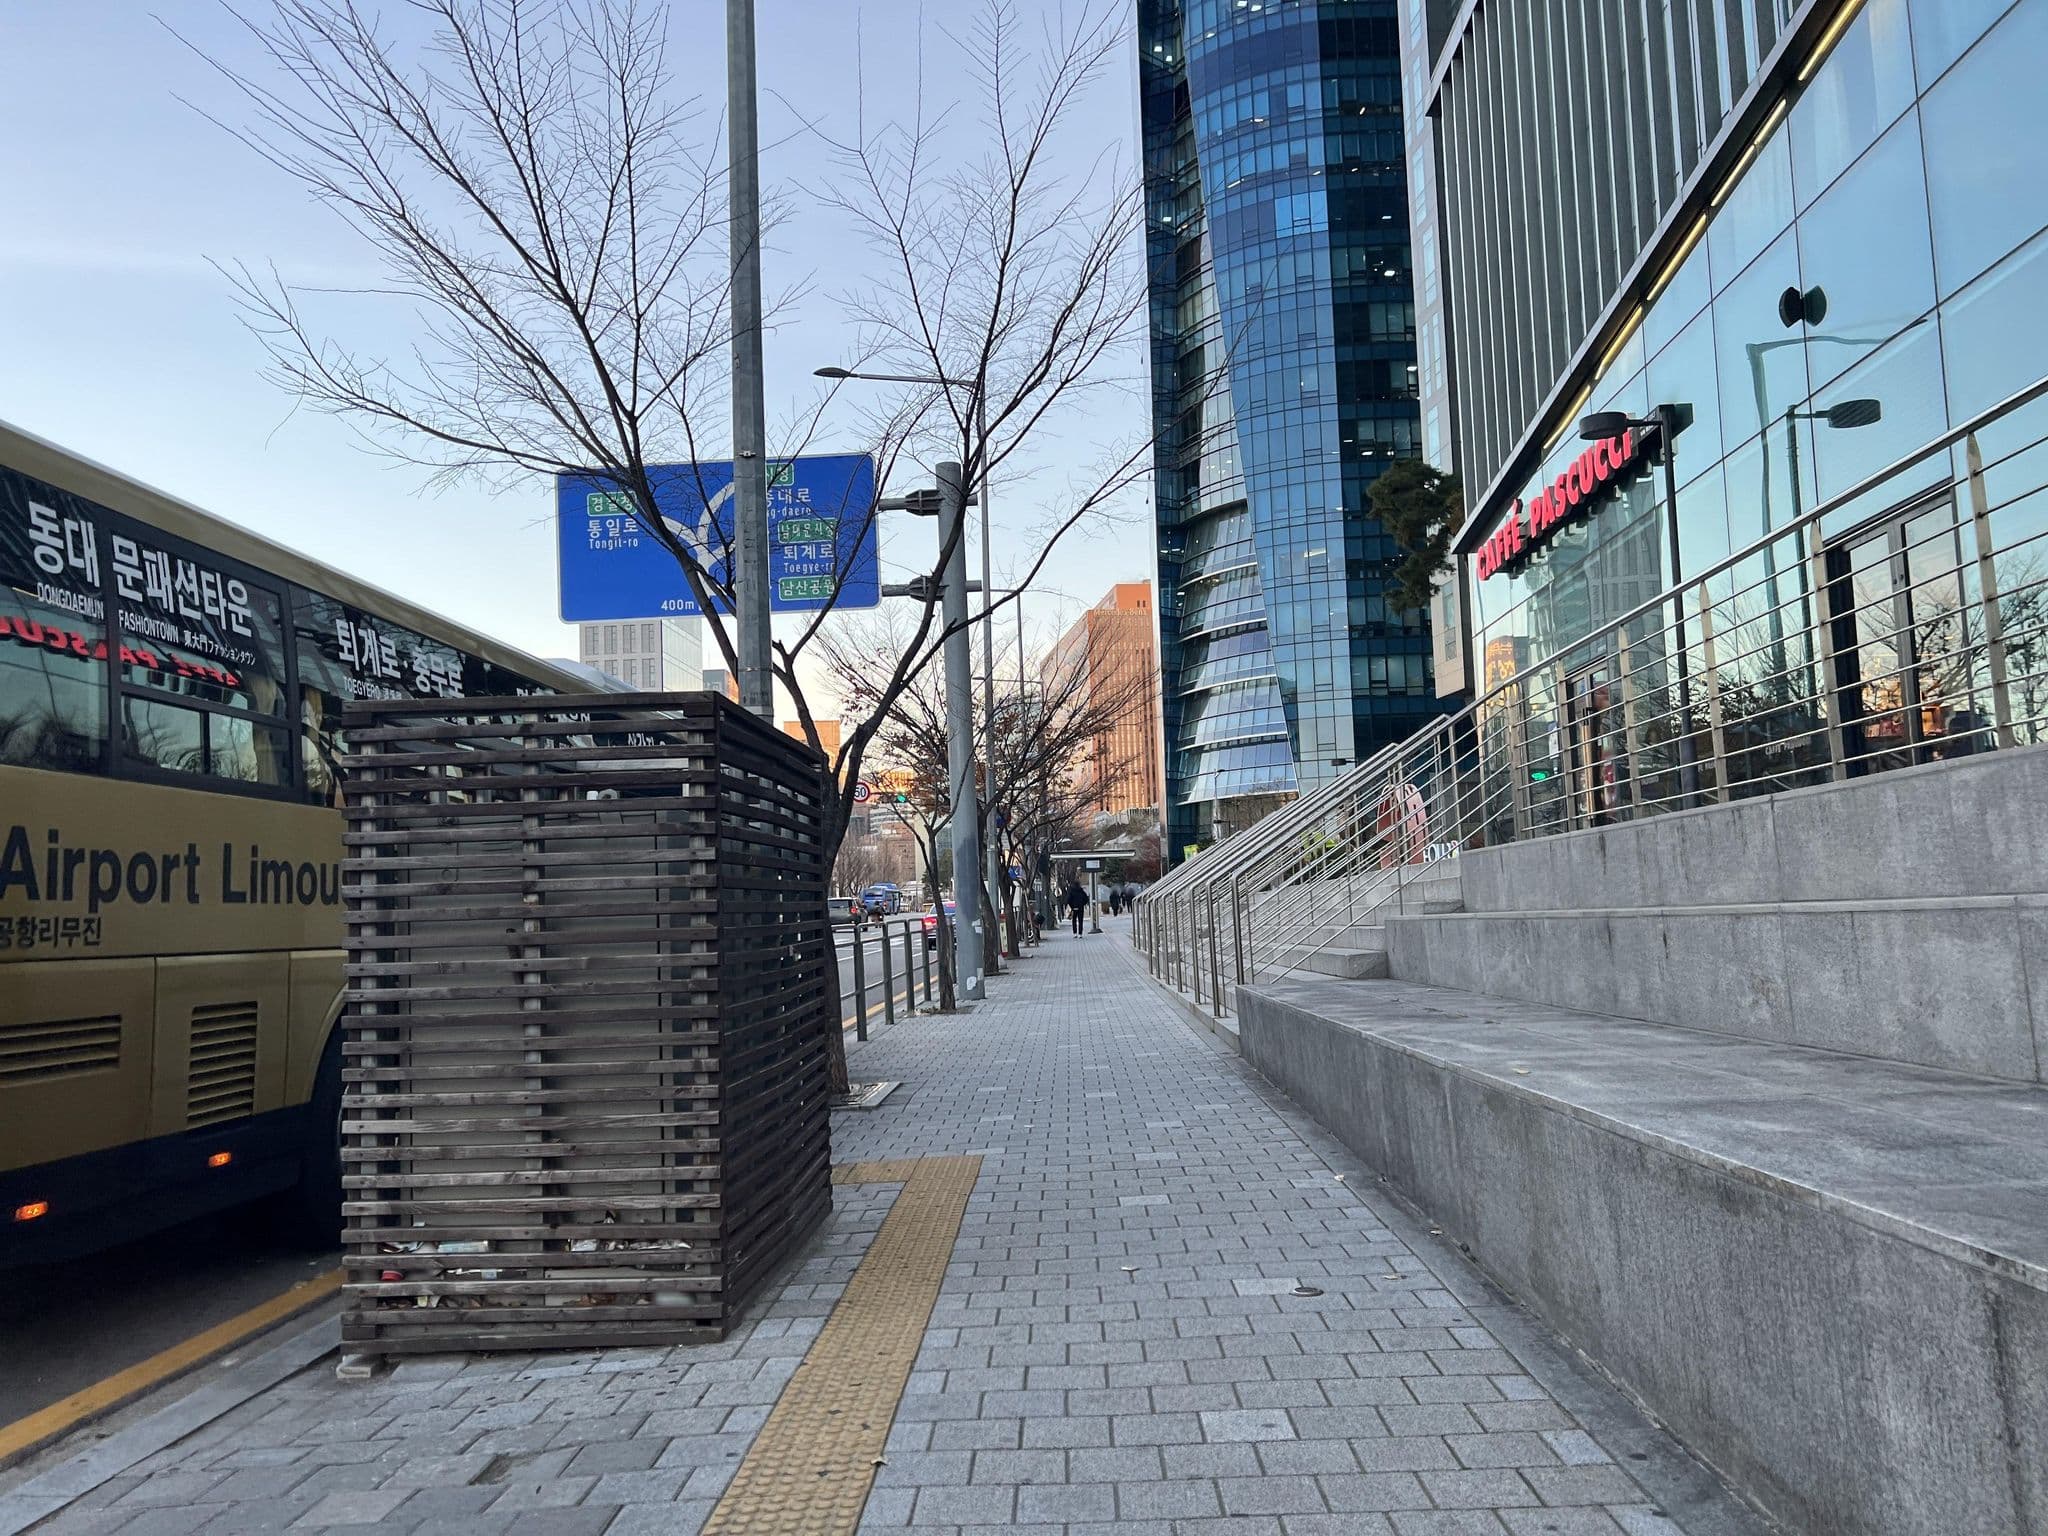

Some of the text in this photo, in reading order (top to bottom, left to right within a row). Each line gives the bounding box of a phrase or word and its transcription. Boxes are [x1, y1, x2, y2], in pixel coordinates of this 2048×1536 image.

[1529, 429, 1632, 538] PASCUCCI
[587, 518, 639, 539] 통일로
[589, 537, 639, 551] Tongil-ro
[784, 543, 835, 560] 퇴계로
[782, 579, 836, 597] 남산공원
[36, 582, 179, 643] DONGDAEMUN FASHIONTOWN
[661, 600, 695, 611] 400m
[0, 825, 201, 914] Airport
[0, 916, 101, 949] 공항리무진
